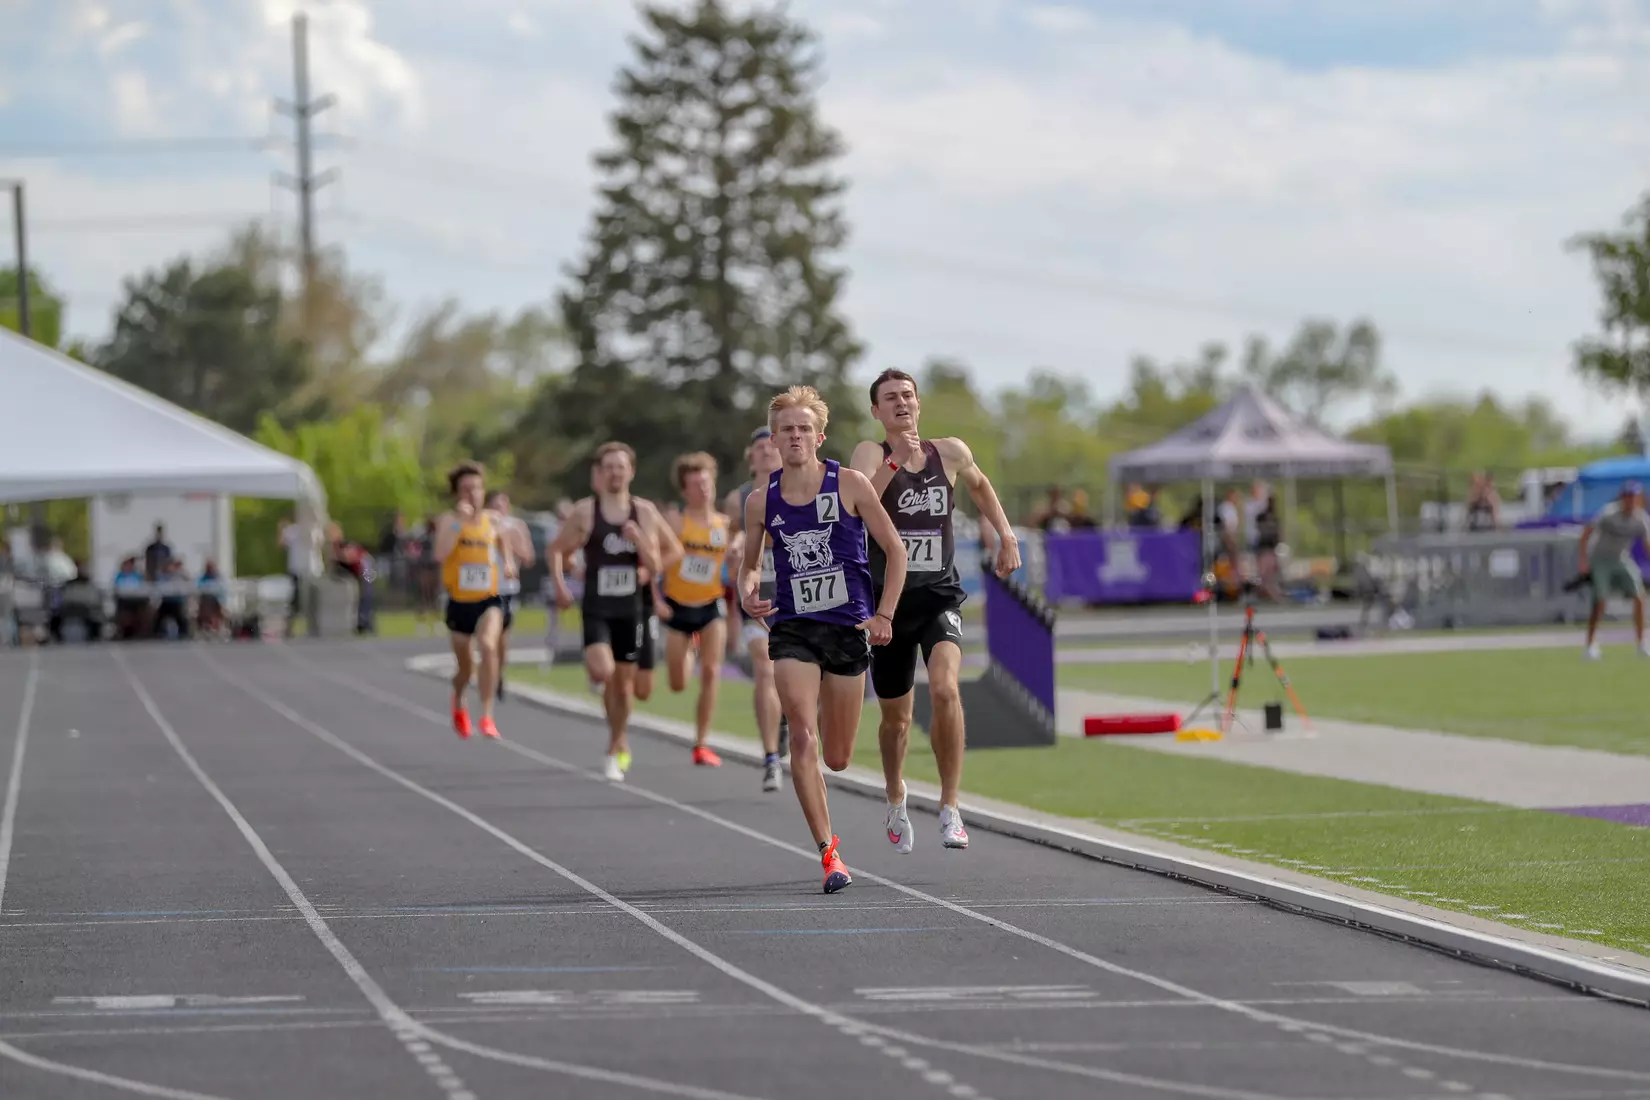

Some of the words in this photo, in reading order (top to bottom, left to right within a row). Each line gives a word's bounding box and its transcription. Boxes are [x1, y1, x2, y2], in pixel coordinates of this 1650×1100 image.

[821, 495, 835, 521] 2
[933, 488, 944, 514] 3
[800, 575, 836, 604] 577
